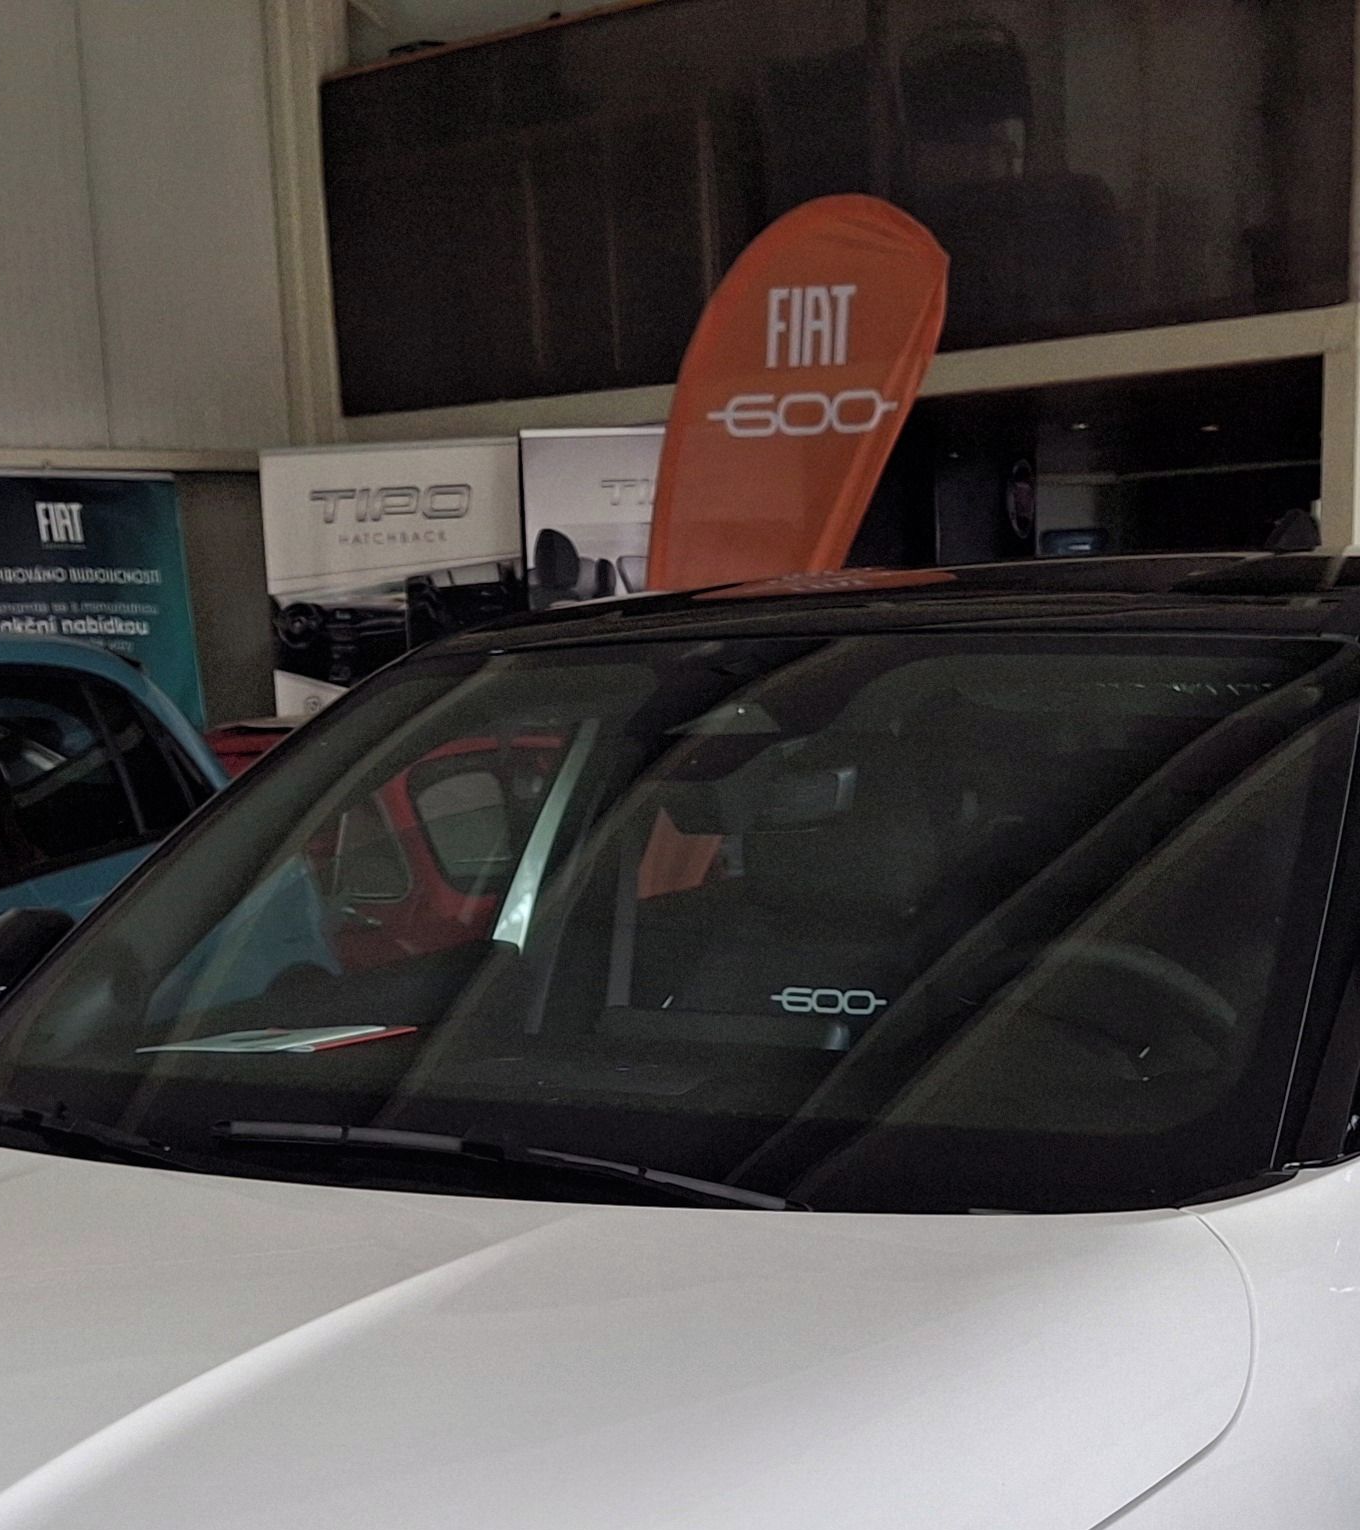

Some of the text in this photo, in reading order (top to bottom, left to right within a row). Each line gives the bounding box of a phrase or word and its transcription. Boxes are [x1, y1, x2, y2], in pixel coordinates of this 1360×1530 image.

[766, 285, 857, 368] FIAT
[707, 389, 898, 437] 600
[35, 501, 85, 543] FIAT
[309, 484, 471, 524] TIPO
[339, 530, 447, 546] HATCHBACK
[771, 986, 888, 1015] 600
